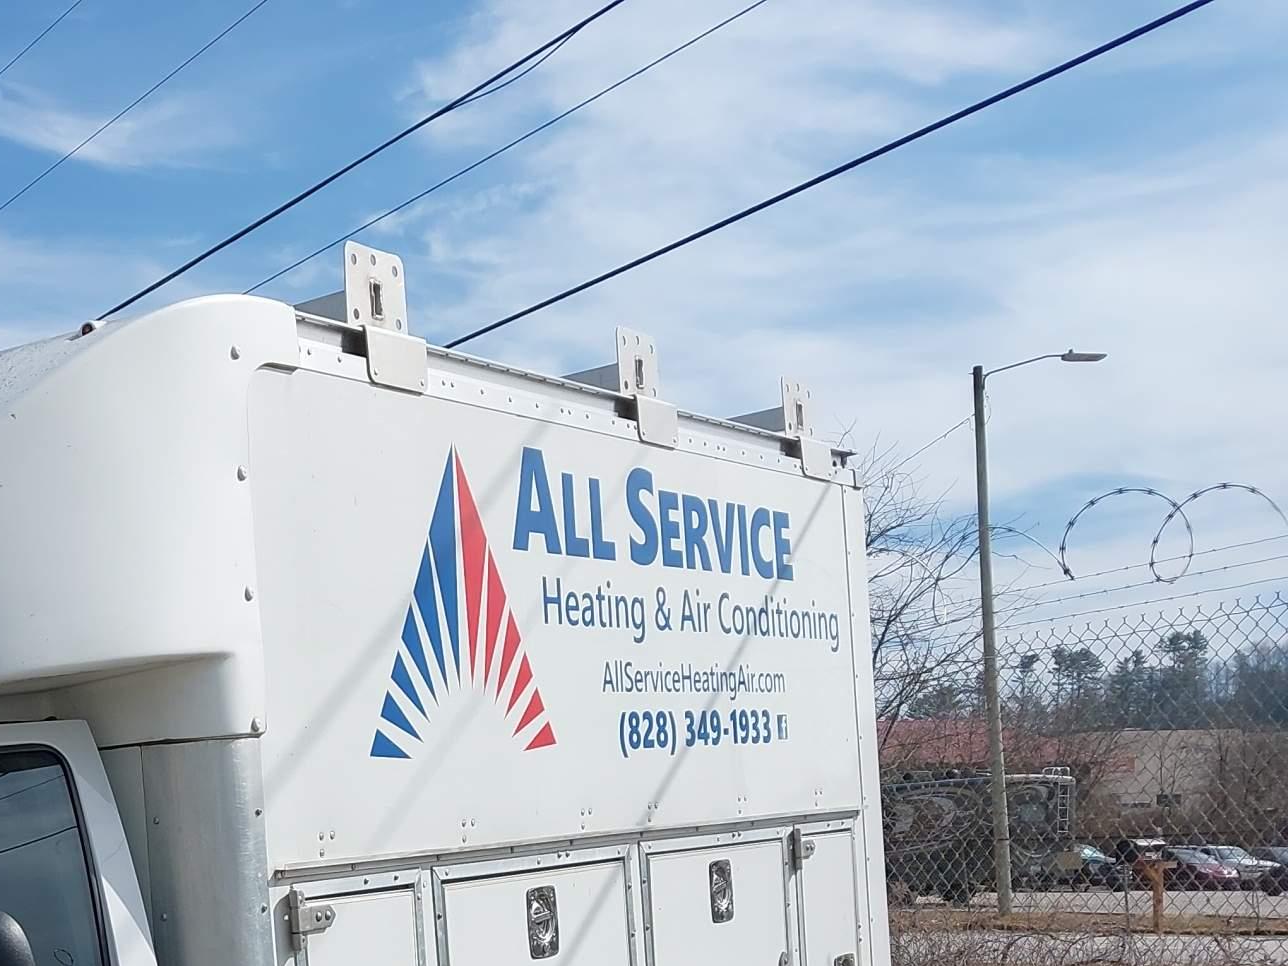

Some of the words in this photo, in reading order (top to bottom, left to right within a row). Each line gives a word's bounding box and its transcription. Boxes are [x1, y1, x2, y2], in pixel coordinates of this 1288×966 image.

[513, 446, 616, 561] ALL
[626, 466, 794, 581] SERVICE
[543, 576, 646, 643] Heating
[655, 587, 672, 630] &
[681, 589, 711, 633] Air
[718, 592, 840, 652] Conditioning
[603, 661, 786, 700] AllServiceHeatingAir.com
[619, 710, 676, 756] (828)
[685, 708, 772, 748] 349-1933
